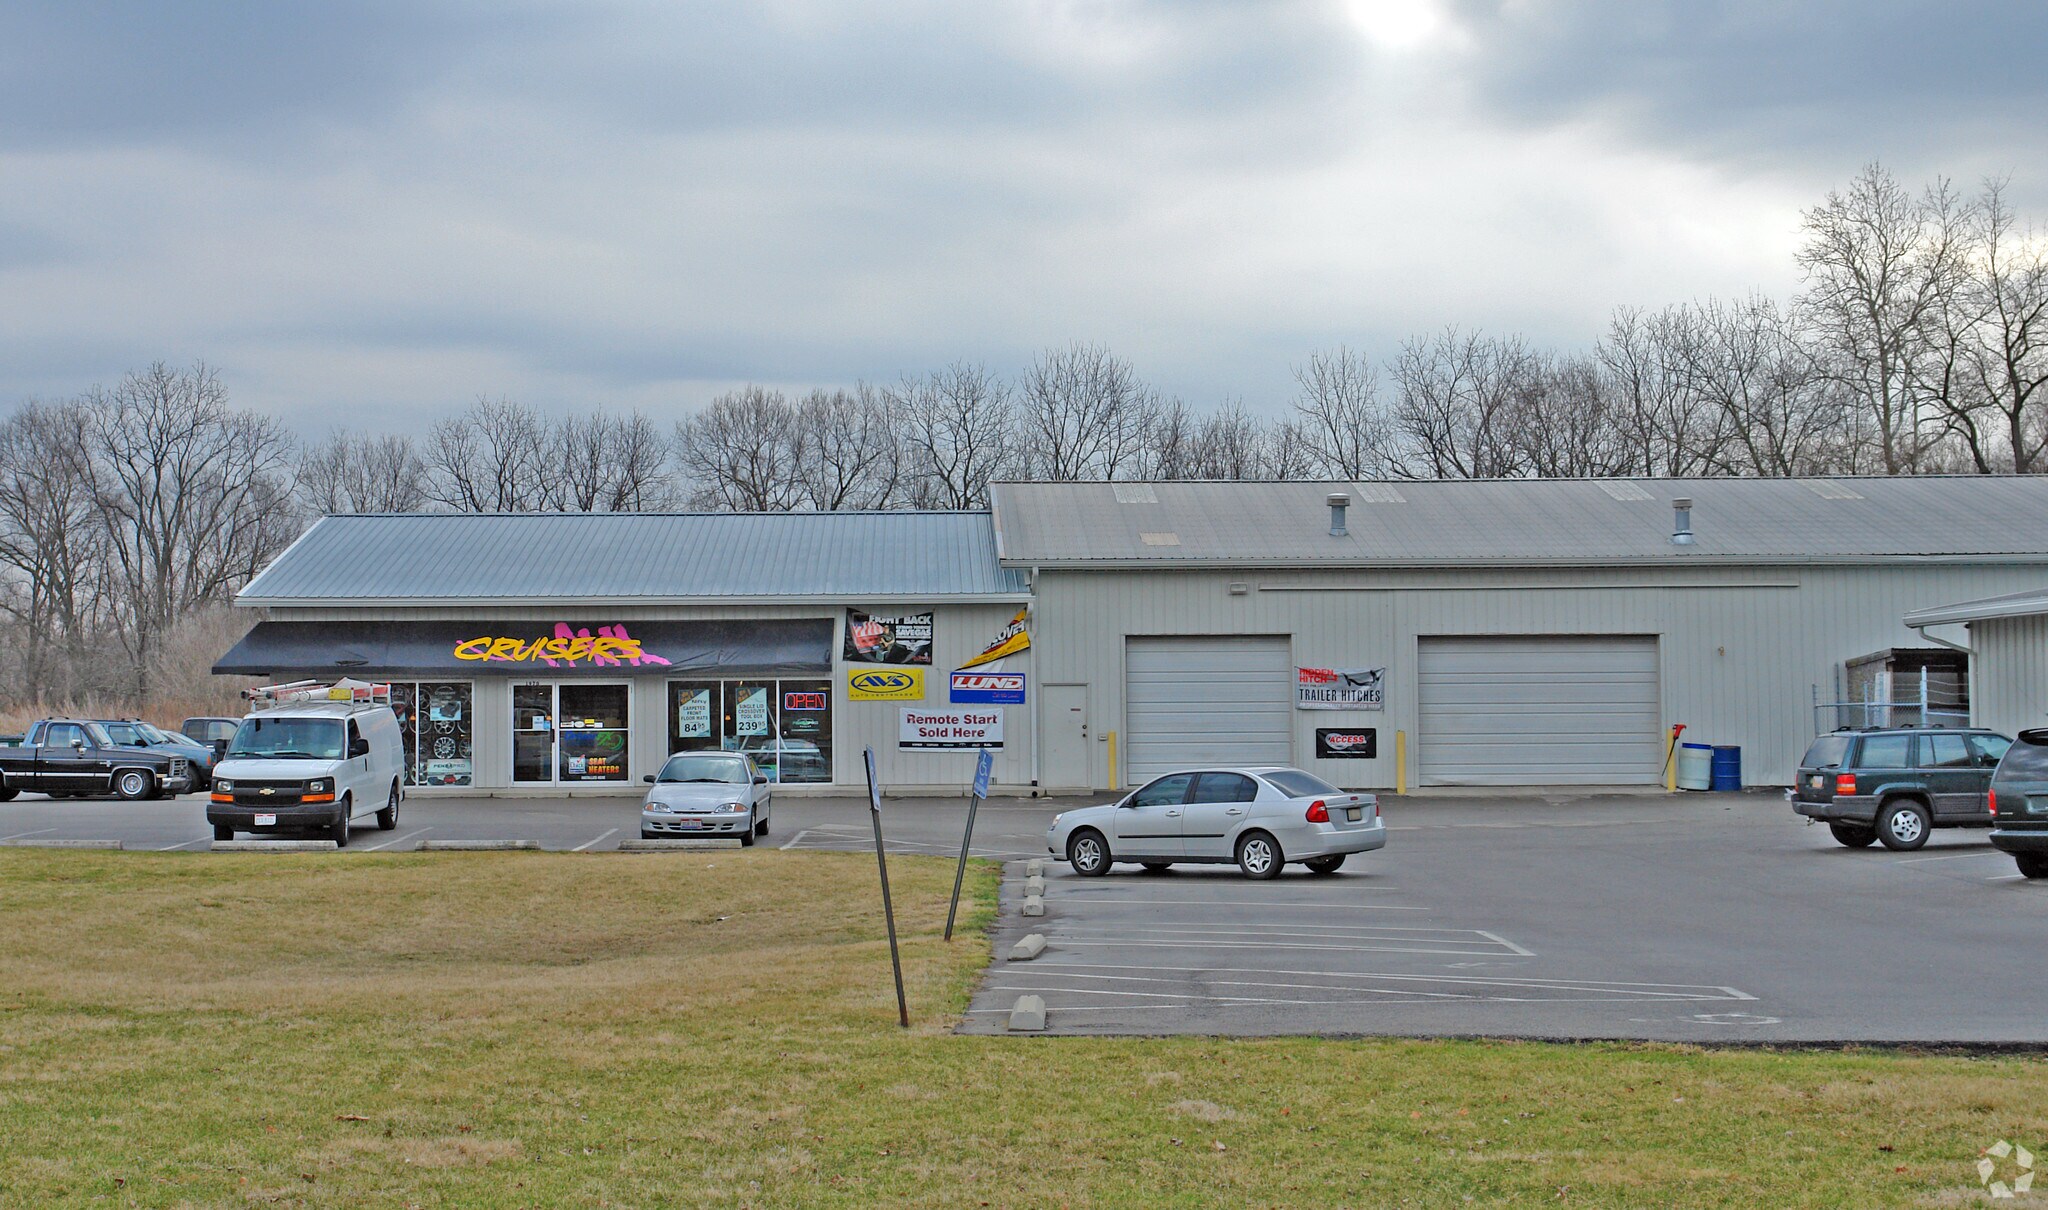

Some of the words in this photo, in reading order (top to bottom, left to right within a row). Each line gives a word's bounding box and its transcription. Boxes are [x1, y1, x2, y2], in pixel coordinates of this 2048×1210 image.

[903, 615, 931, 624] BACK
[454, 636, 641, 662] CRUISERS
[857, 676, 904, 687] AVS
[955, 677, 1023, 689] LUND
[1298, 675, 1328, 683] HITCH
[1299, 688, 1337, 701] TRAILER
[1341, 689, 1381, 702] HITCHES
[785, 693, 825, 709] OPEN
[906, 714, 960, 725] Remote
[963, 714, 998, 725] Start
[684, 723, 698, 733] 84
[738, 721, 758, 731] 239
[918, 727, 949, 738] Sold
[953, 727, 986, 738] Here
[1329, 735, 1365, 743] ACCESS
[588, 766, 620, 774] HEATERS
